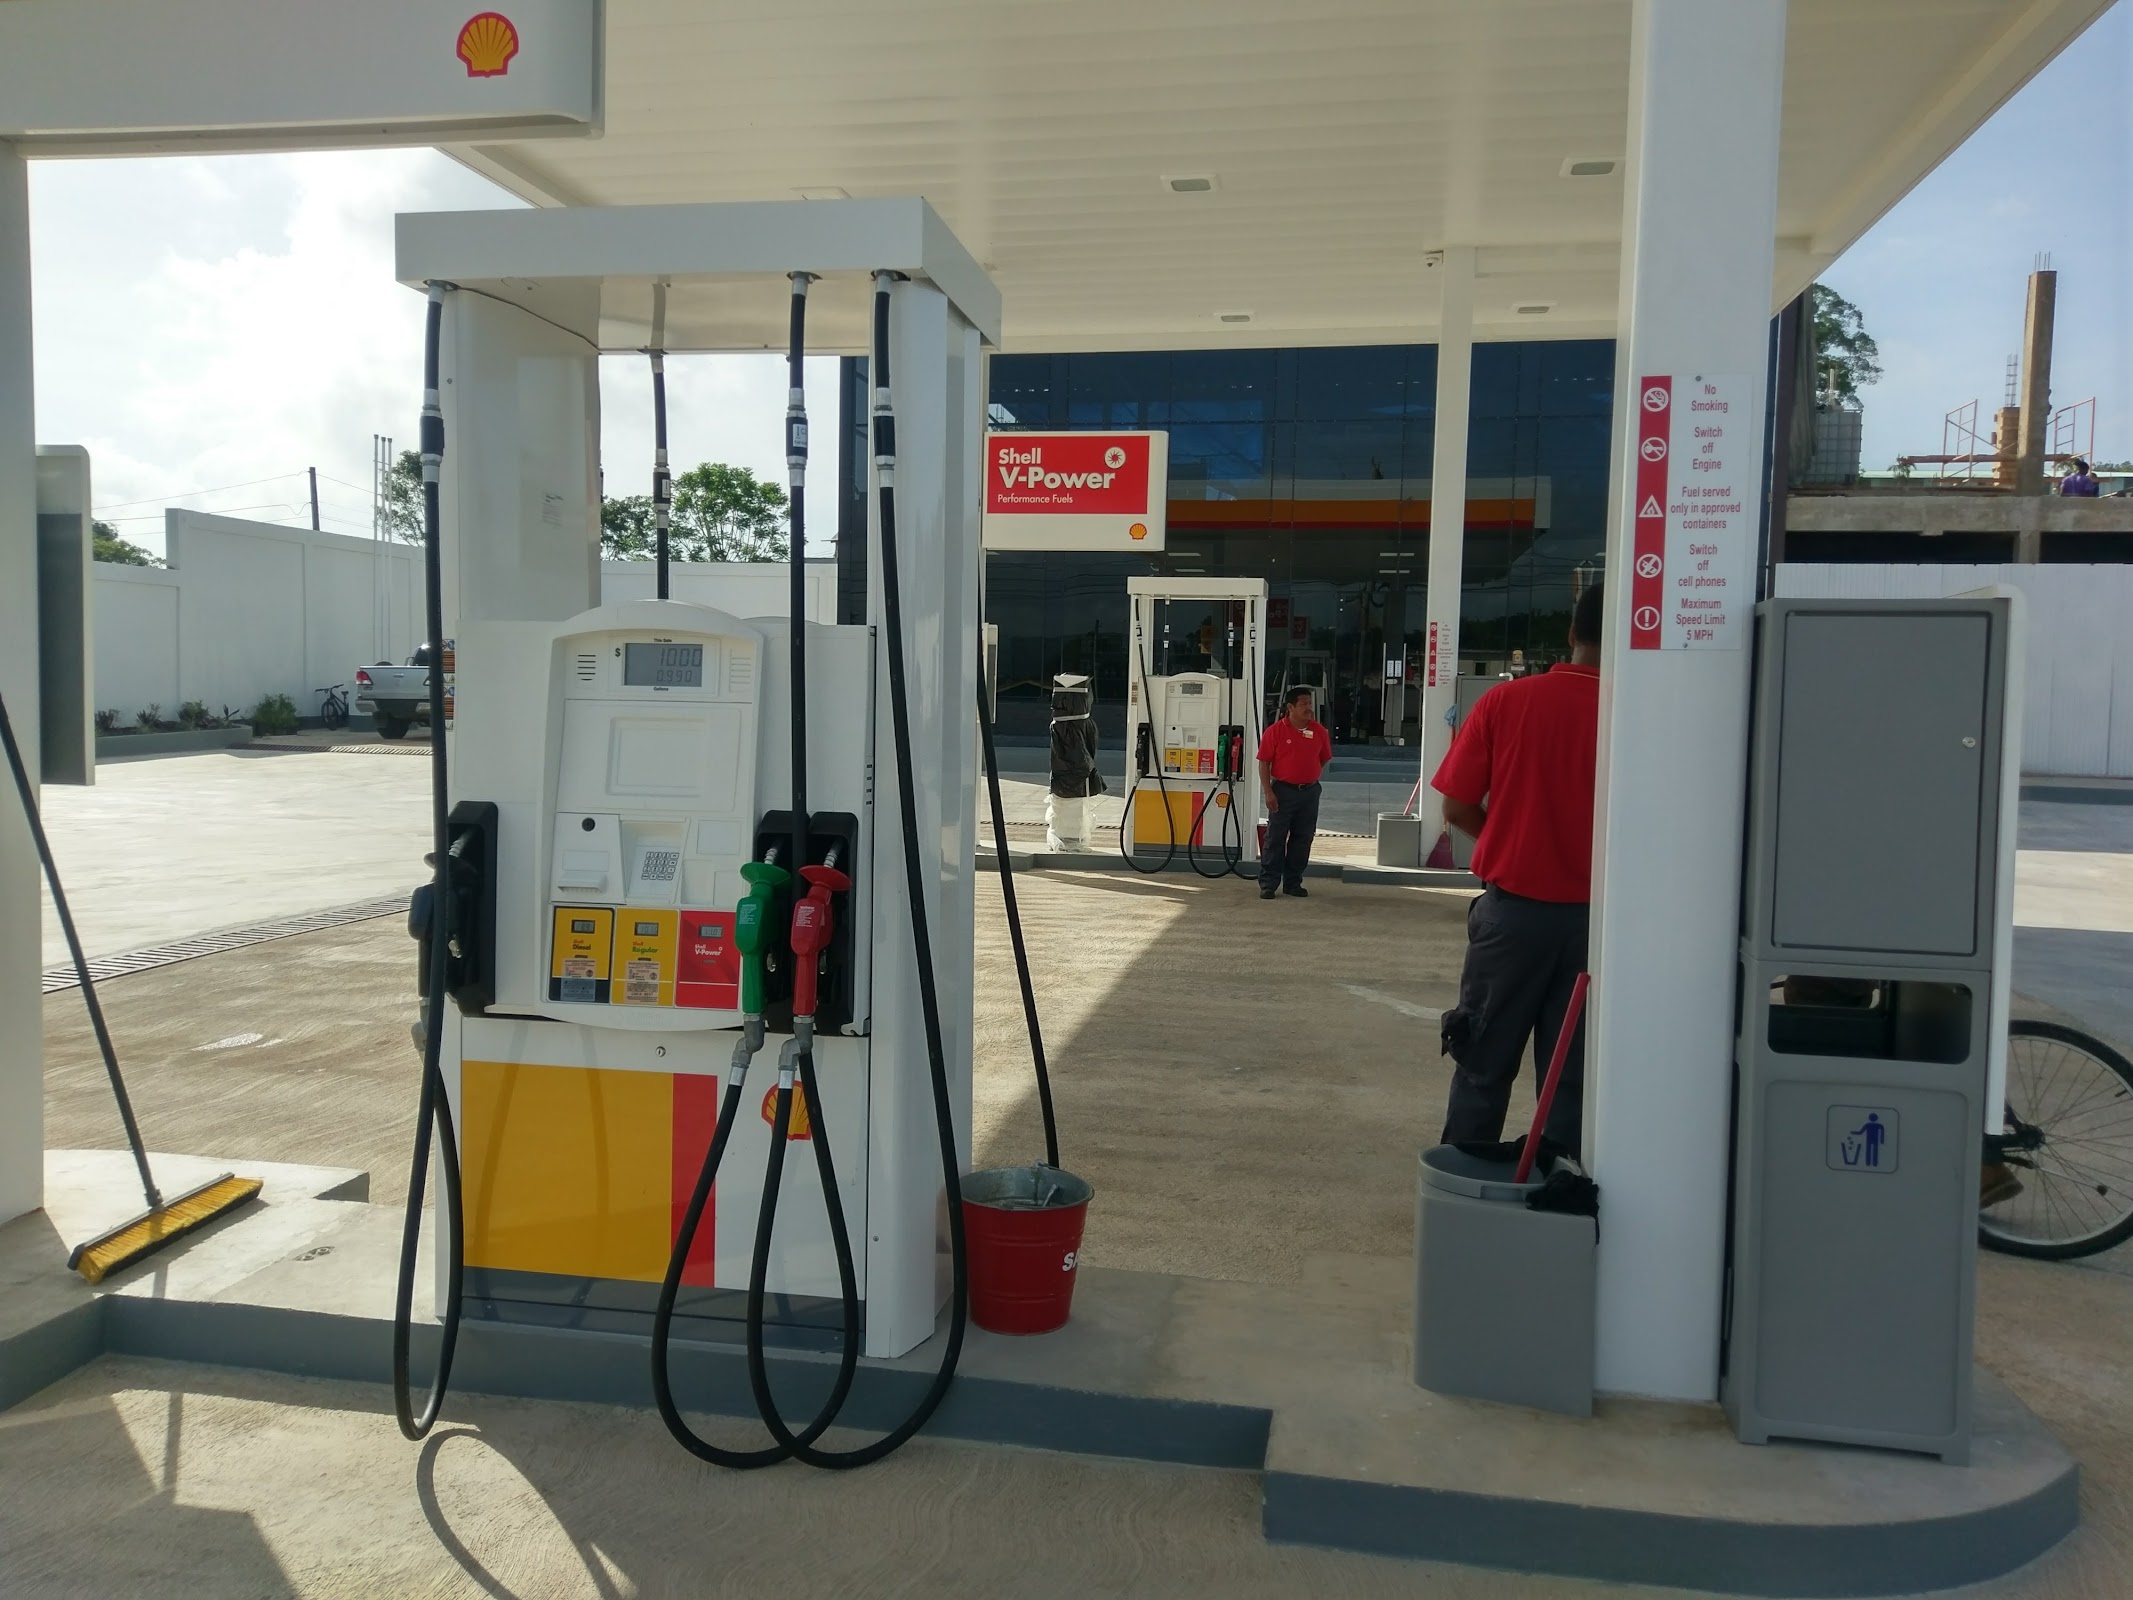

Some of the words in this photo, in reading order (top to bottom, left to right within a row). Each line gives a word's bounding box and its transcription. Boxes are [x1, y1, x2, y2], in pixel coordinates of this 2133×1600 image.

[1704, 384, 1717, 395] No
[1691, 400, 1728, 413] Smoking
[1694, 426, 1723, 438] Switch
[1702, 442, 1714, 454] off
[998, 447, 1042, 465] Shell
[1692, 458, 1722, 472] Engine
[998, 466, 1116, 489] V-Power
[1682, 486, 1700, 497] Fuel
[1702, 486, 1731, 497] served
[997, 493, 1050, 504] Performance
[1052, 493, 1073, 504] Fuels
[1670, 502, 1689, 516] only
[1690, 502, 1699, 513] in
[1700, 502, 1741, 515] approved
[1682, 518, 1727, 529] containers
[1689, 544, 1718, 555] Switch
[1697, 560, 1710, 571] off
[1678, 576, 1693, 587] cell
[1695, 576, 1727, 589] phones
[1681, 598, 1722, 609] Maximum
[1676, 614, 1702, 627] Speed
[1704, 614, 1726, 625] Limit
[1686, 630, 1692, 641] 5
[1693, 630, 1714, 641] MPH
[614, 647, 621, 658] $
[572, 943, 591, 951] Diesel
[632, 946, 658, 954] Regular
[694, 948, 722, 956] V-Power
